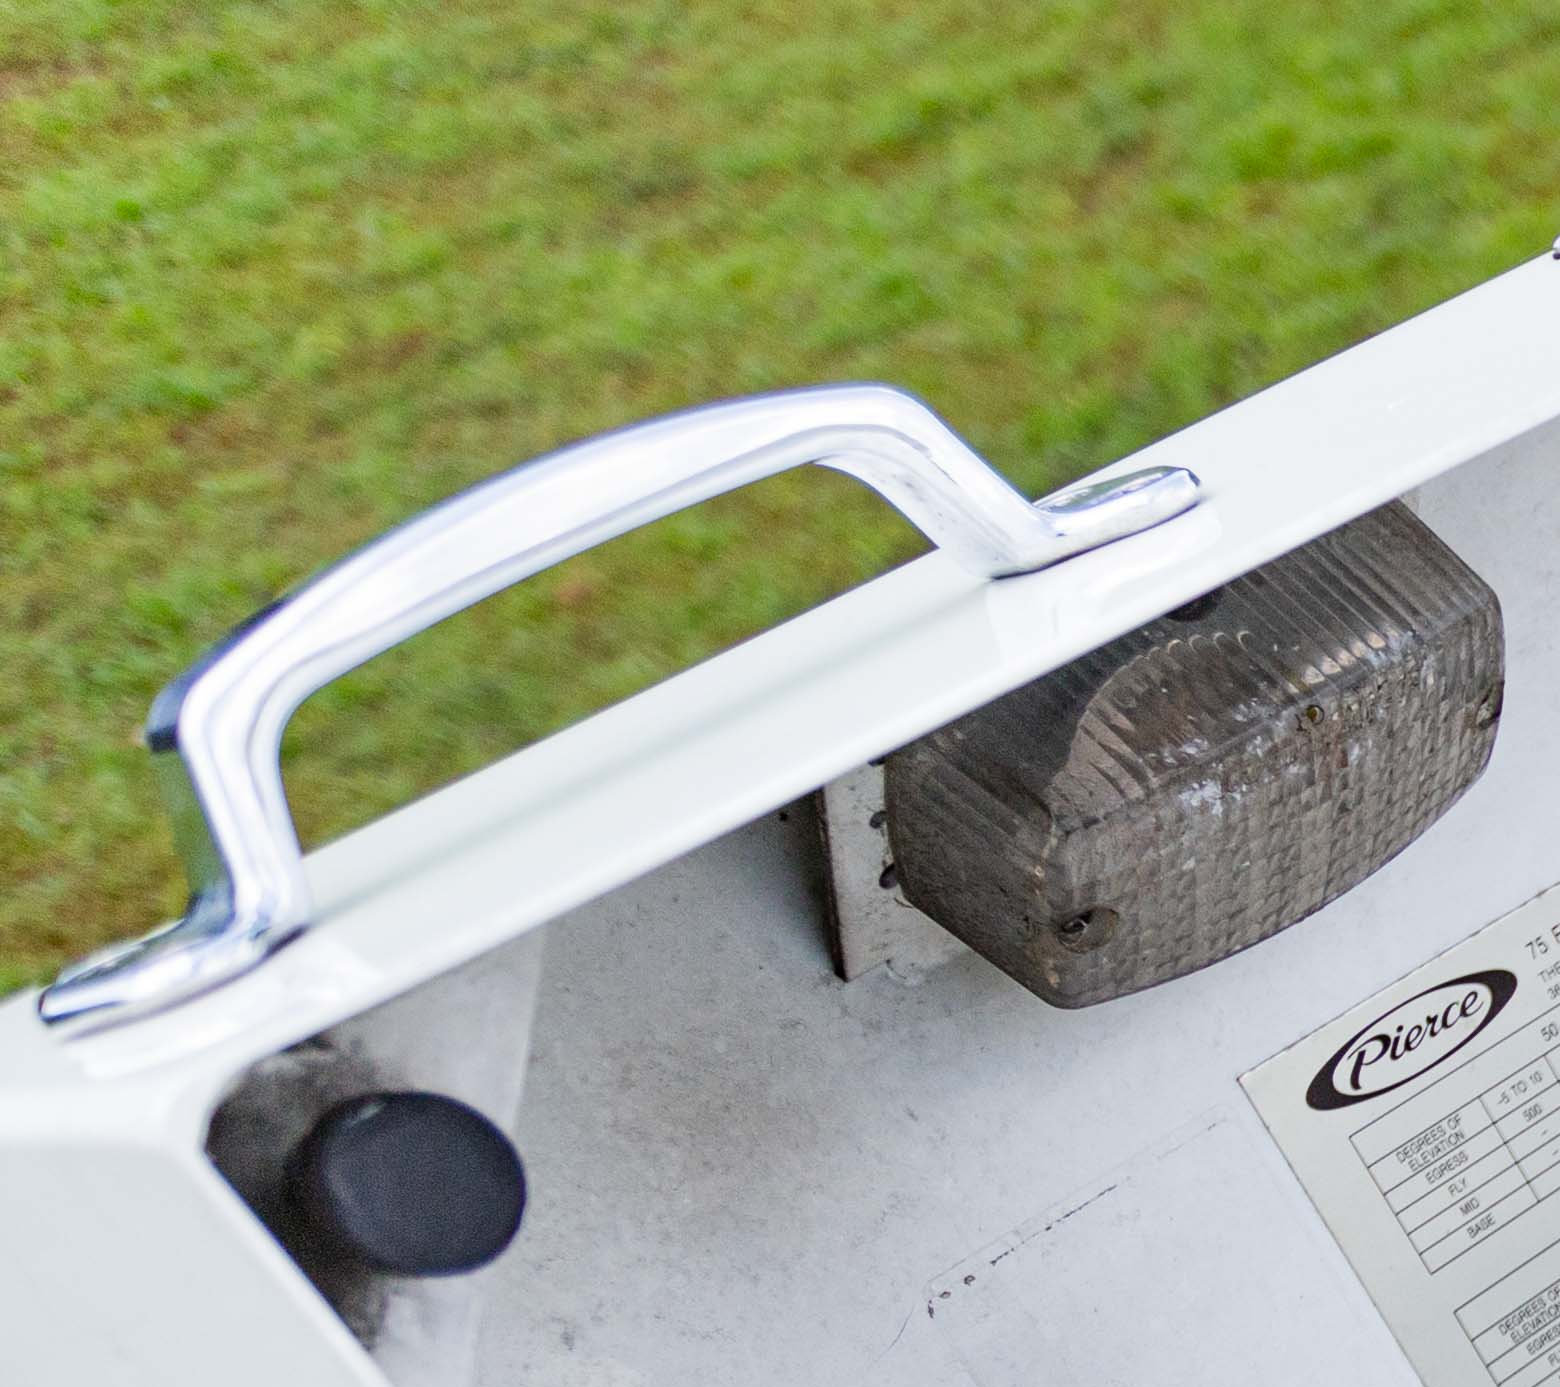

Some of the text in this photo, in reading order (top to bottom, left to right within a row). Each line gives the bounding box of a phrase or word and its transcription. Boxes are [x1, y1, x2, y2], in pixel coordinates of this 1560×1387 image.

[1524, 935, 1549, 959] 75
[1348, 985, 1484, 1090] Pierce
[1539, 1021, 1559, 1042] 50
